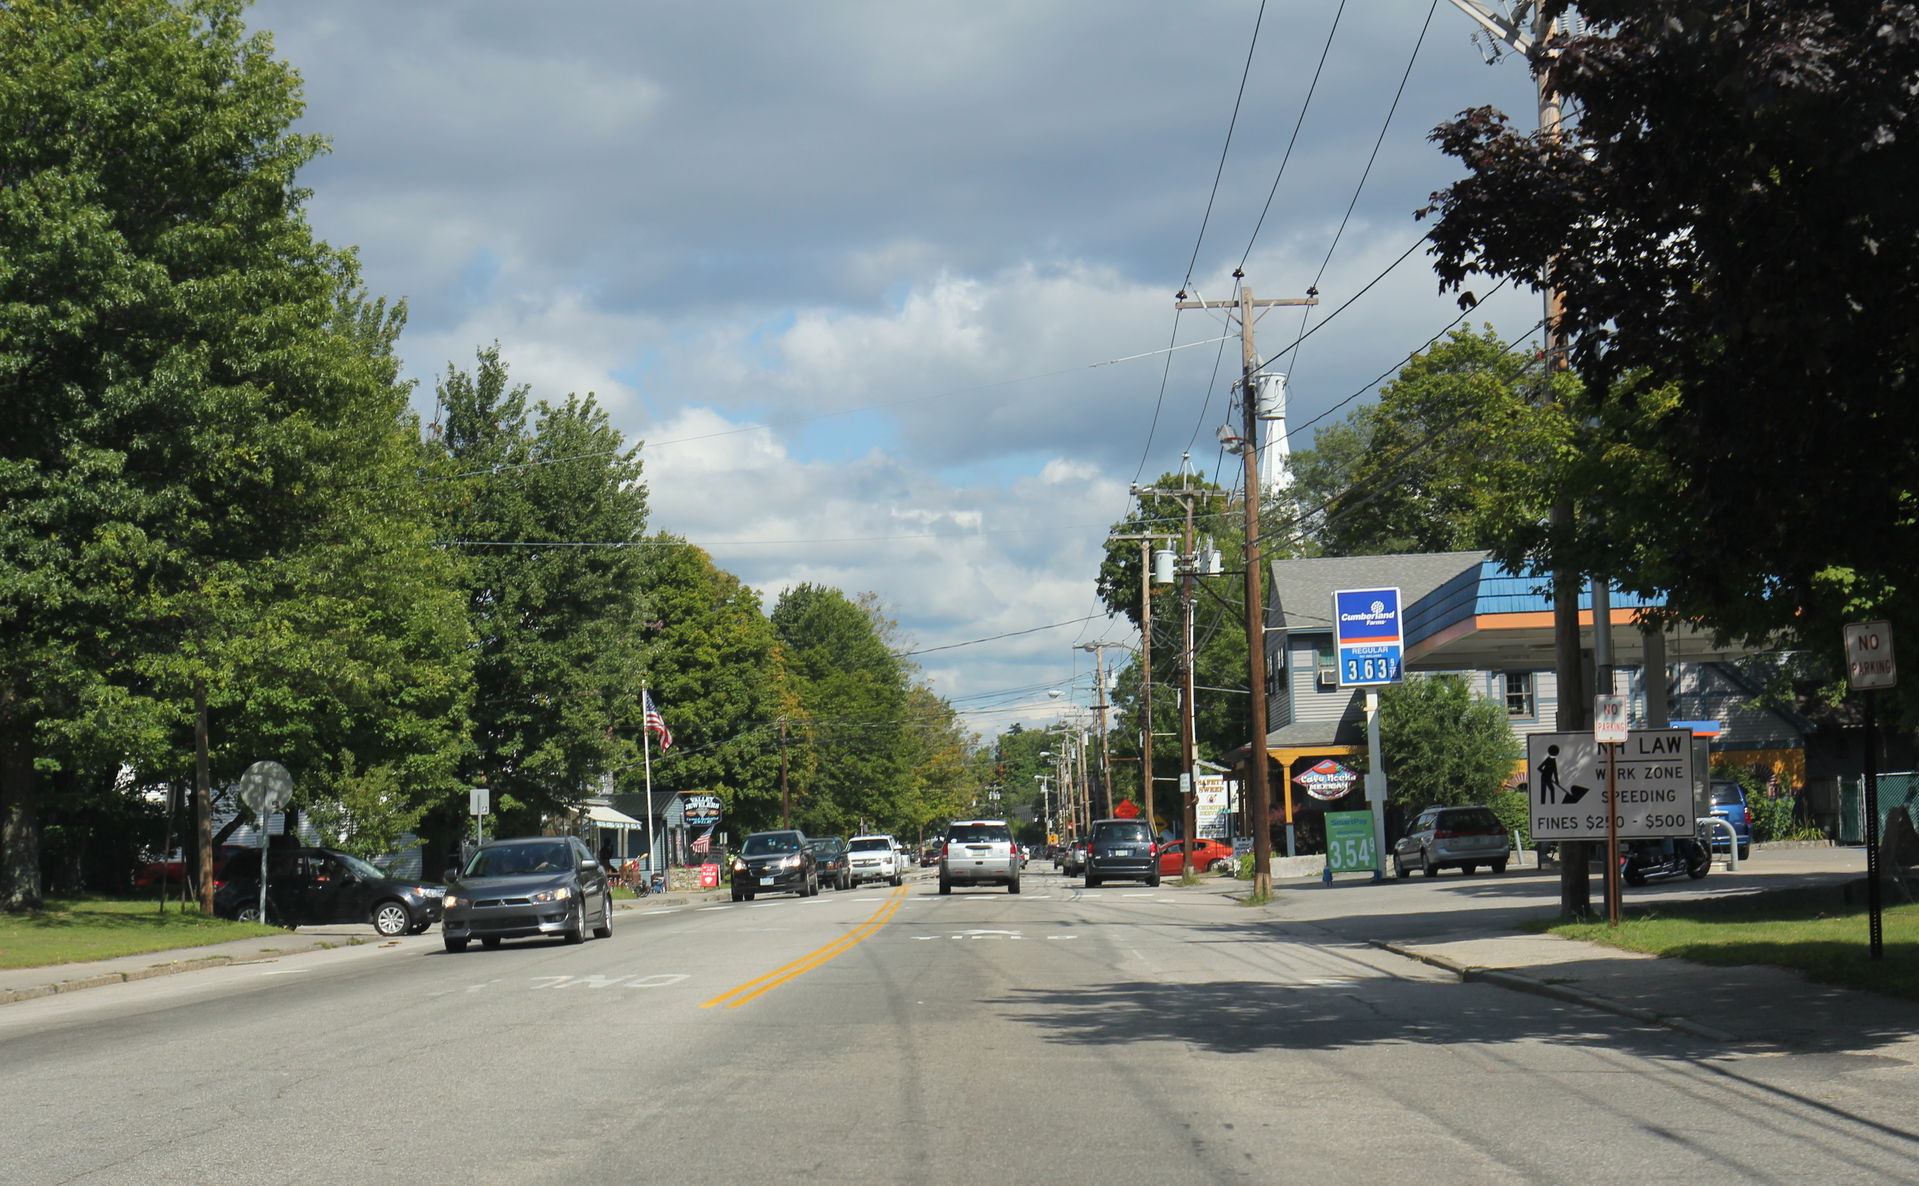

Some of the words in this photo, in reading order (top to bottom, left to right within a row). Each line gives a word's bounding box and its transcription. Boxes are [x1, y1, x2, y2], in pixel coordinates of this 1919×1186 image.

[1341, 610, 1395, 621] Cumberland
[1352, 646, 1388, 654] REGULAR
[1858, 633, 1879, 651] NO
[1348, 658, 1387, 680] 3.63
[1851, 660, 1891, 676] PARKING
[1603, 703, 1618, 715] NO
[1597, 721, 1625, 731] PARKING
[1639, 736, 1682, 755] LAW
[1595, 768, 1636, 780] WRK
[1644, 766, 1684, 780] ZONE
[1538, 816, 1578, 830] FINES
[1645, 813, 1686, 829] $500
[1329, 839, 1370, 869] 3.54
